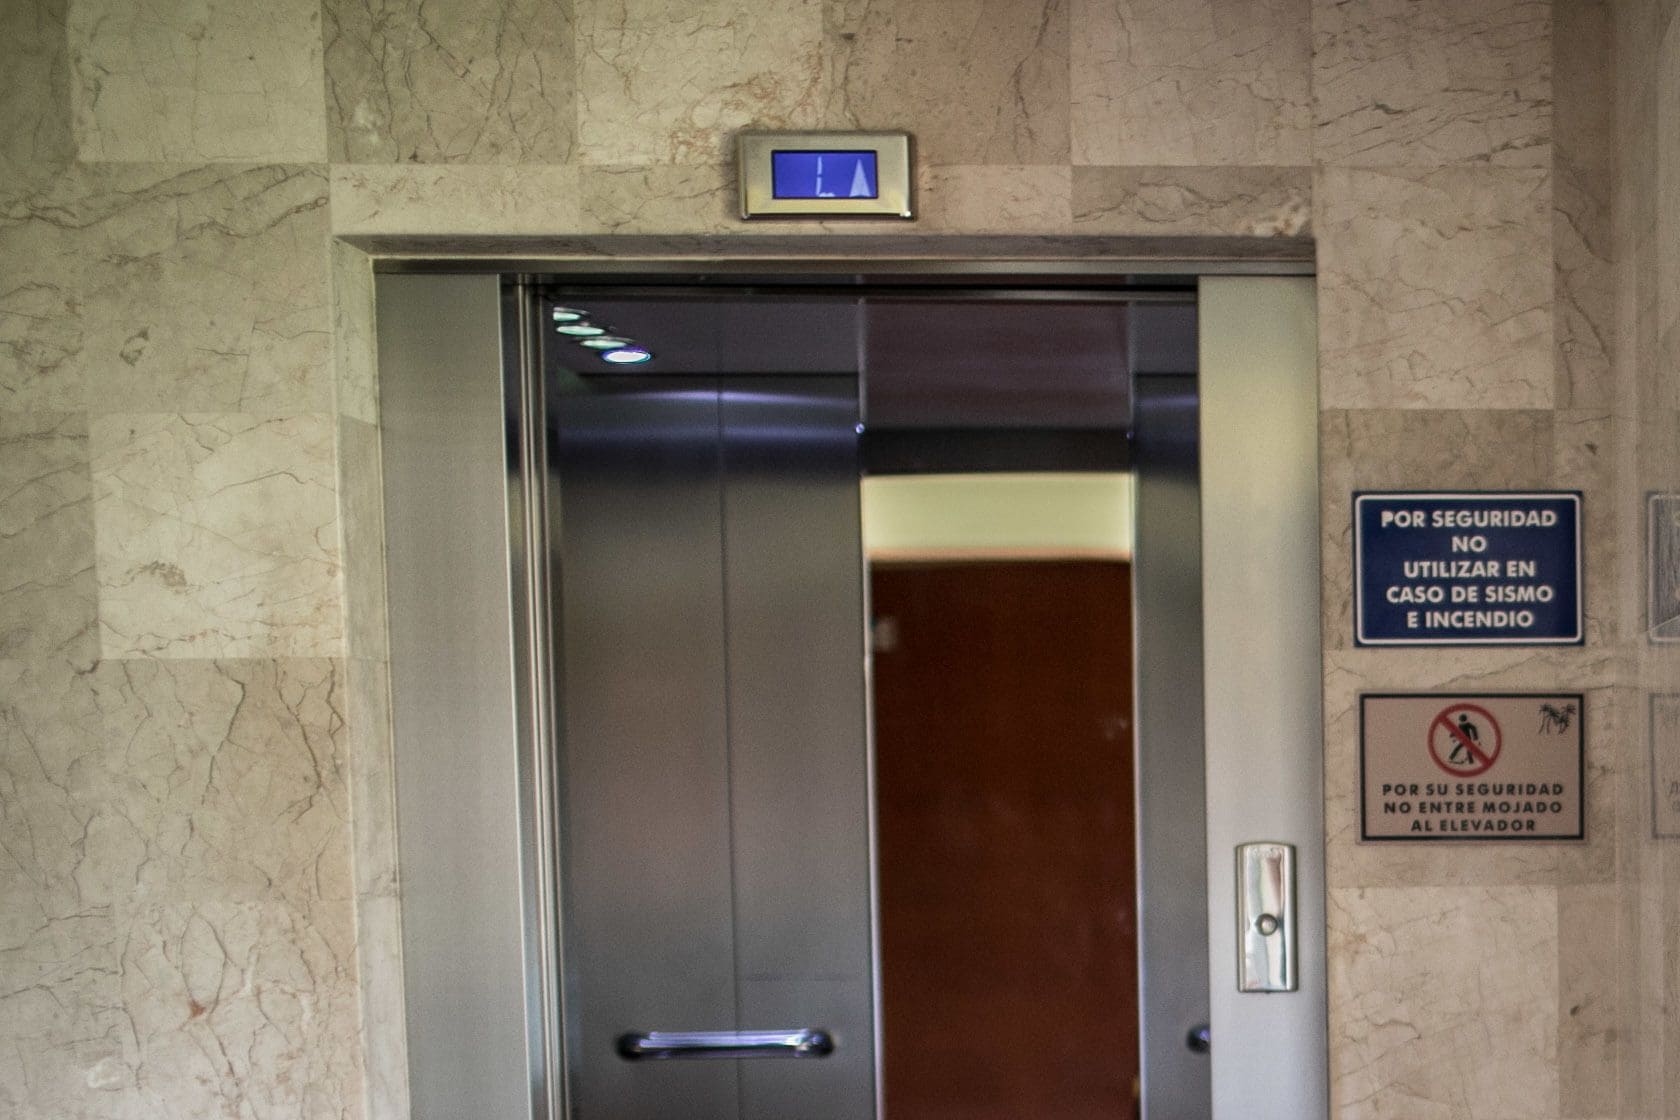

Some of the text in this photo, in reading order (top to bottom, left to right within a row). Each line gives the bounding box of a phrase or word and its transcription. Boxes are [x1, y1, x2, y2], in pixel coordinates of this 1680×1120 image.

[1381, 510, 1557, 528] POR SEGURIDAD
[1451, 535, 1487, 553] NO
[1403, 560, 1536, 578] UTILIZAR EN
[1386, 585, 1553, 604] CASO DE SISMO
[1407, 610, 1534, 628] E INCENDIO
[1382, 783, 1563, 796] POR SU SEGURIDAD
[1384, 801, 1562, 814] NO ENTRE MOJADO
[1410, 819, 1536, 832] AL ELEVADOR
